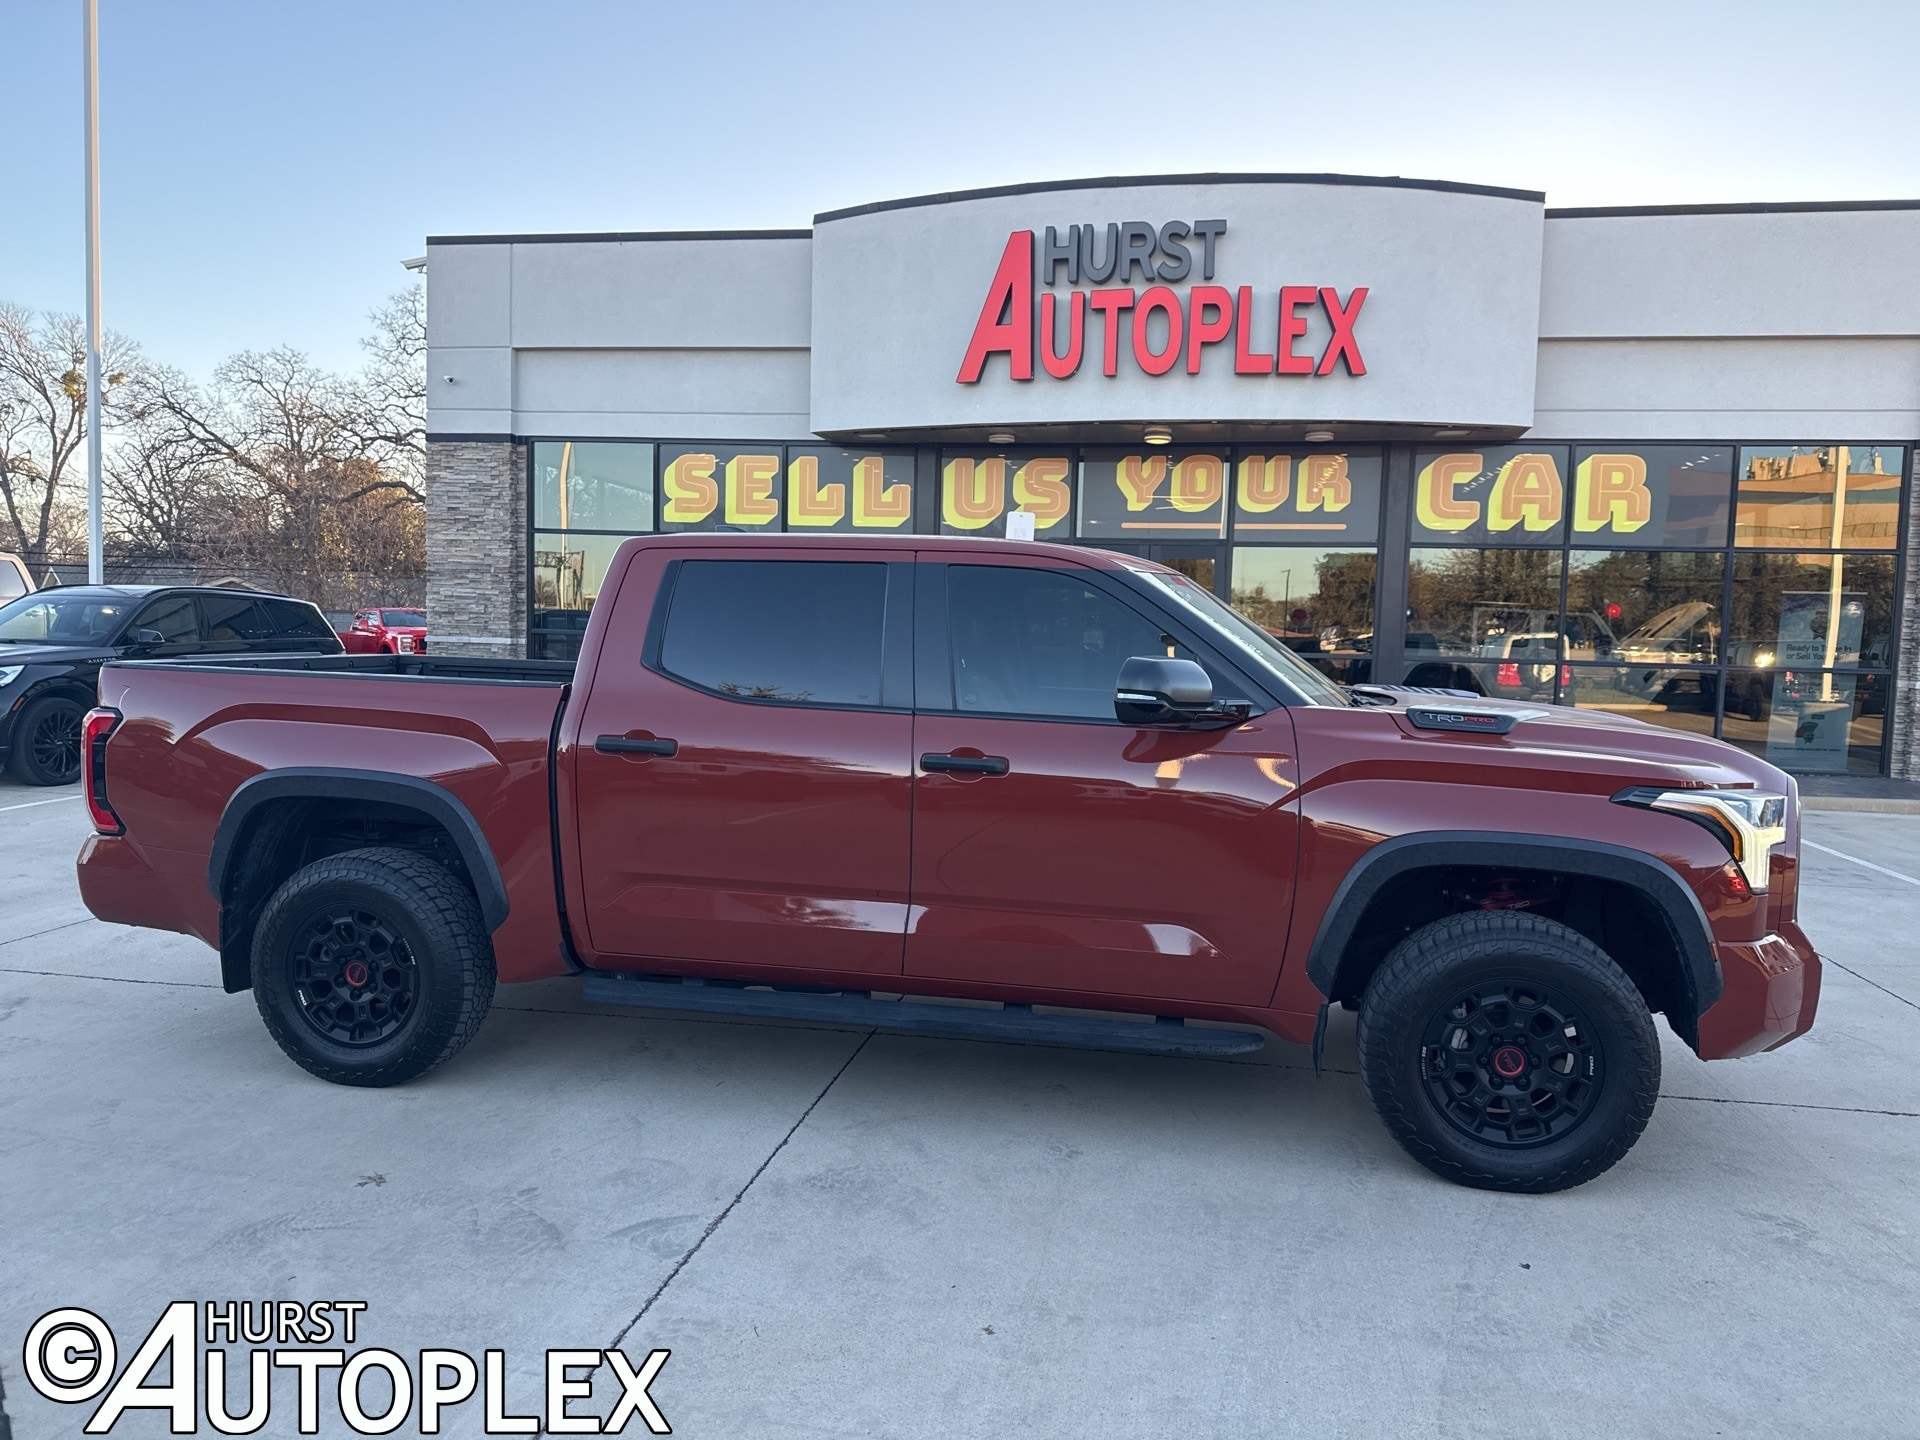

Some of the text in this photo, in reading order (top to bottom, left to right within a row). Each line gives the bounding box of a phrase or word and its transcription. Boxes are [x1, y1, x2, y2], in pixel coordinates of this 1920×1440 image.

[1044, 219, 1227, 285] HURST
[956, 230, 1369, 384] AUTOPLEX
[664, 453, 1651, 532] SELL US YOUR CAR
[1424, 713, 1464, 722] TRD
